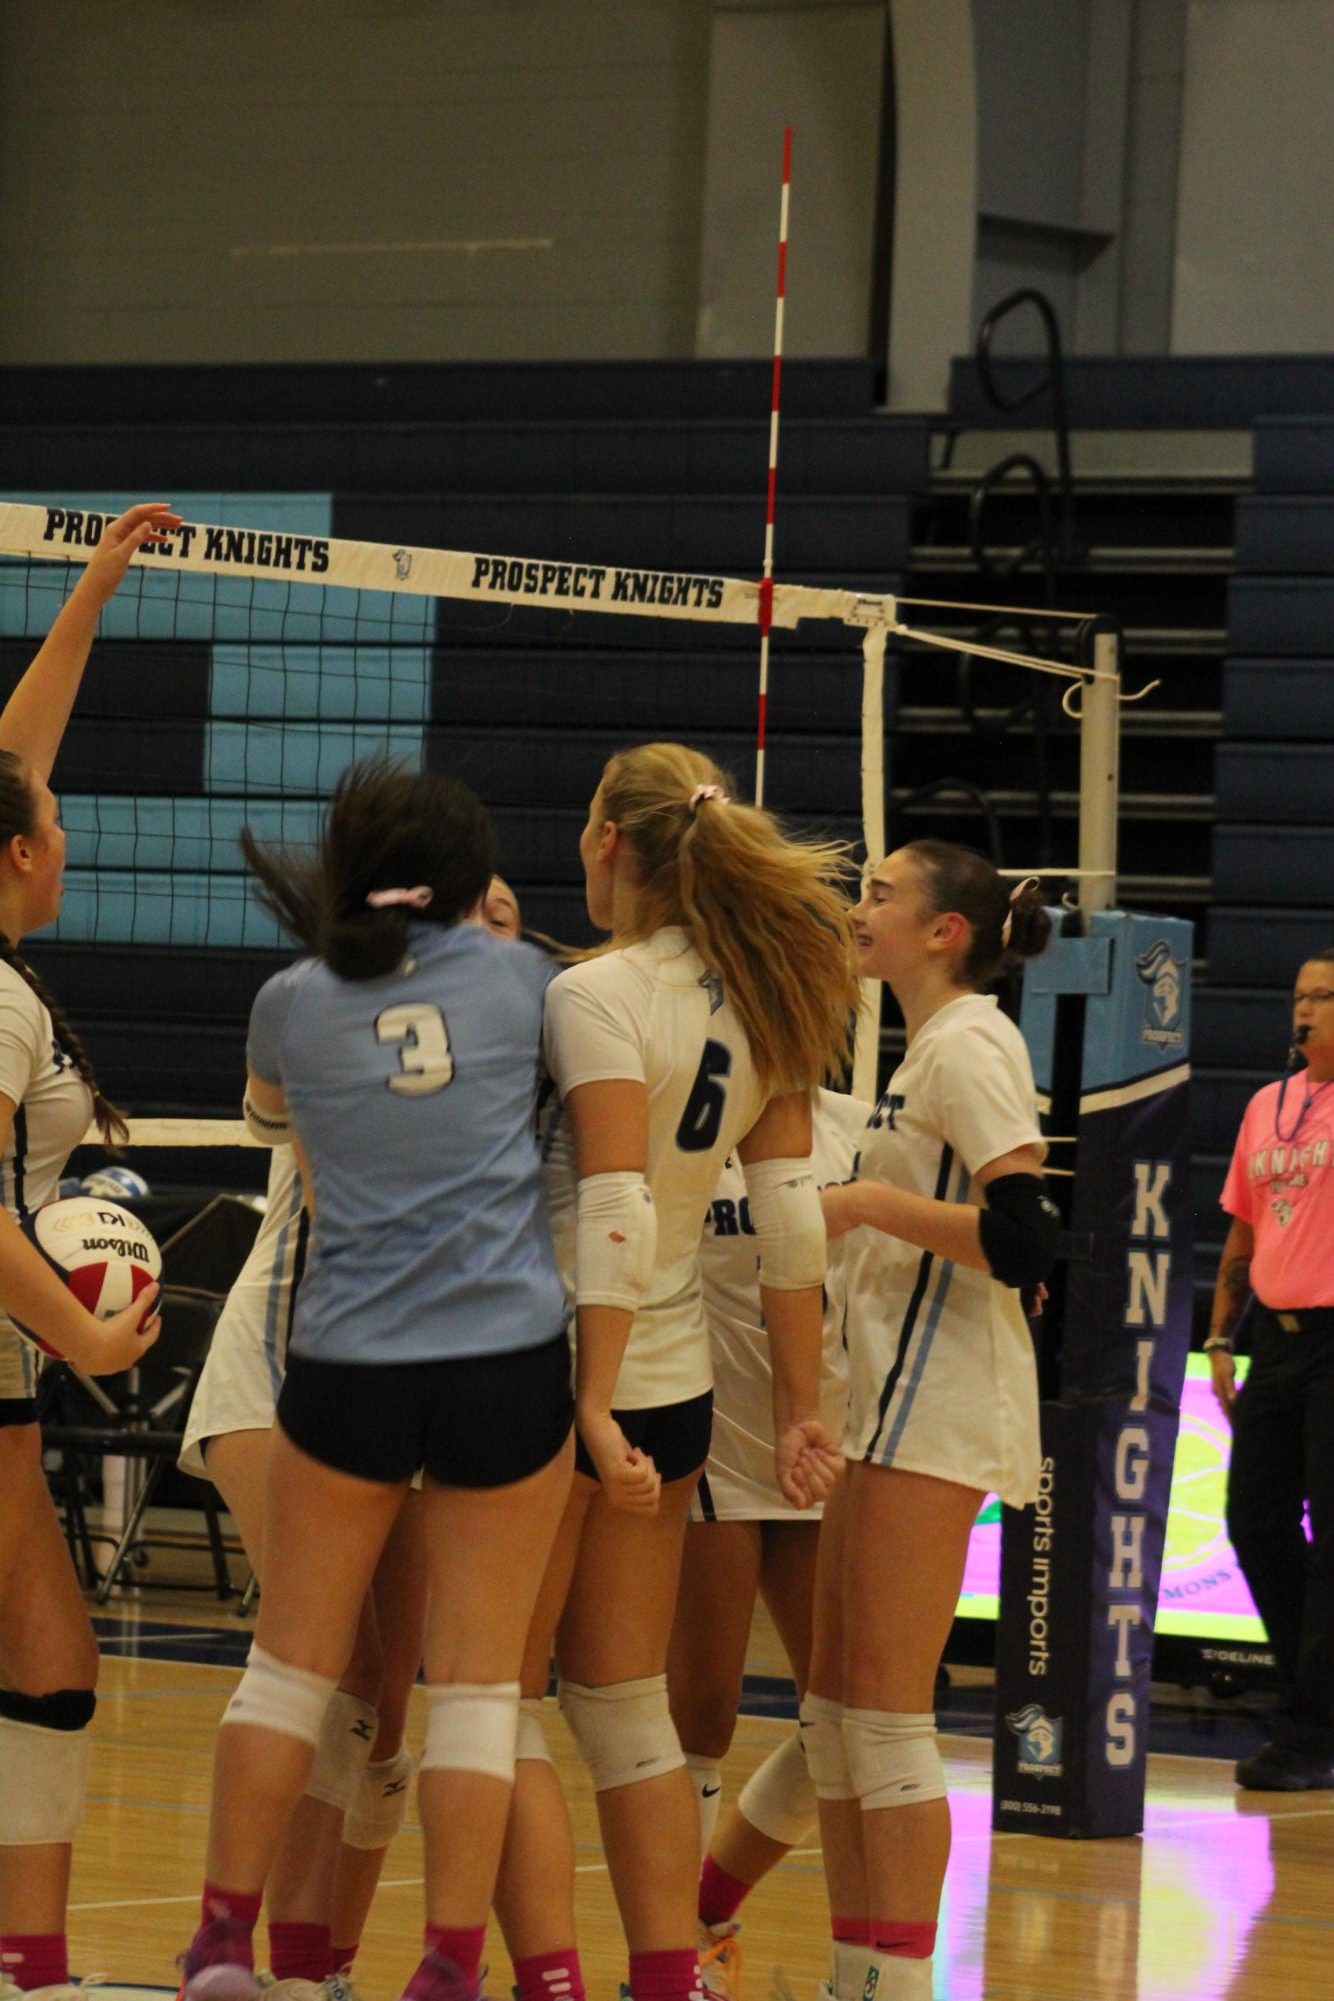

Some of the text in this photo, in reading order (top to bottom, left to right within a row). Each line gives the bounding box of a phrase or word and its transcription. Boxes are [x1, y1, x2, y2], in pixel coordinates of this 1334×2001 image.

[43, 508, 330, 573] PROECT KNIGHTS
[471, 556, 725, 608] PROSPECT KNIGHTS
[375, 1003, 454, 1097] 3
[676, 1038, 730, 1153] 6
[1247, 1140, 1334, 1180] KNIGH
[82, 1237, 150, 1263] Wilson
[1104, 1160, 1173, 1768] KNIGHTS
[1026, 1456, 1055, 1677] sports imports
